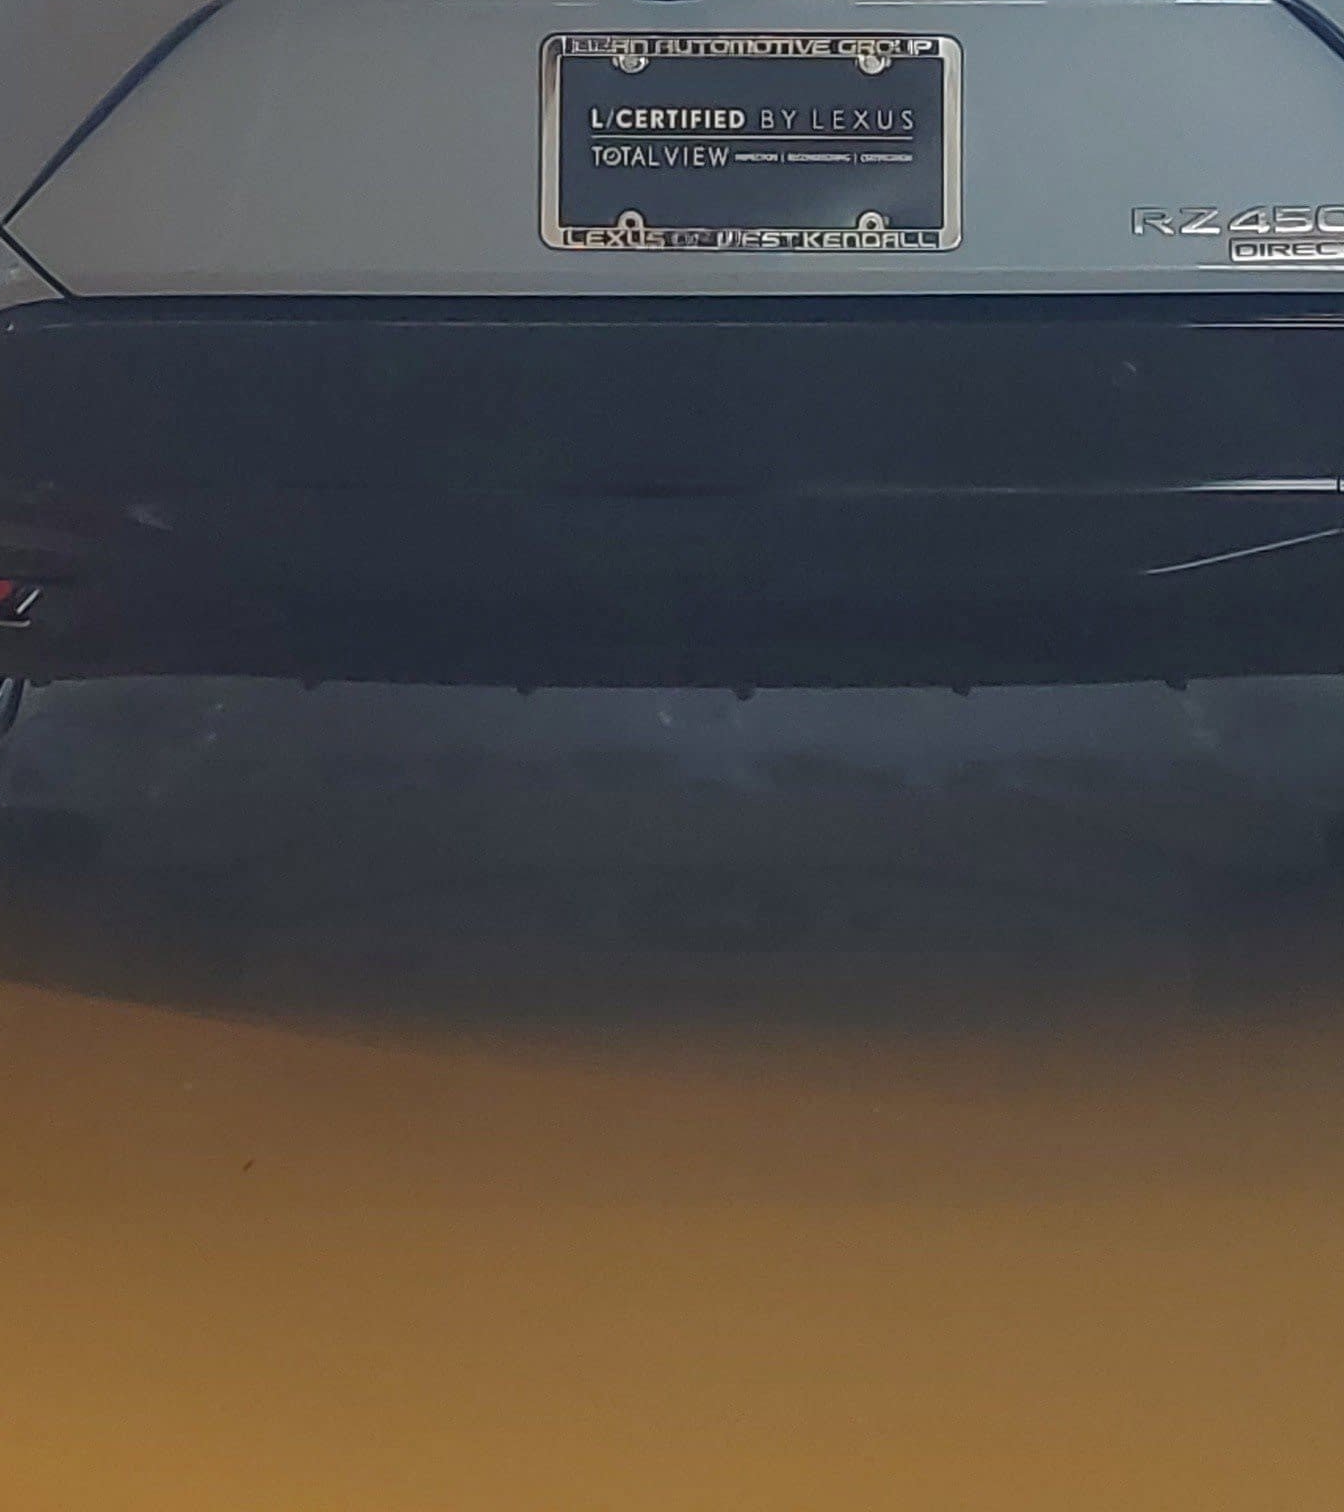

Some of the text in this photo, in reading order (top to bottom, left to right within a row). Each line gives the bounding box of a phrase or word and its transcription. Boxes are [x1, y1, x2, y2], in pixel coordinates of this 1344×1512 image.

[656, 39, 832, 55] AUTOMOTIVE
[760, 109, 797, 130] BY
[811, 109, 914, 131] LEXUS
[567, 231, 666, 247] LEXUS
[803, 232, 938, 249] KENDALL
